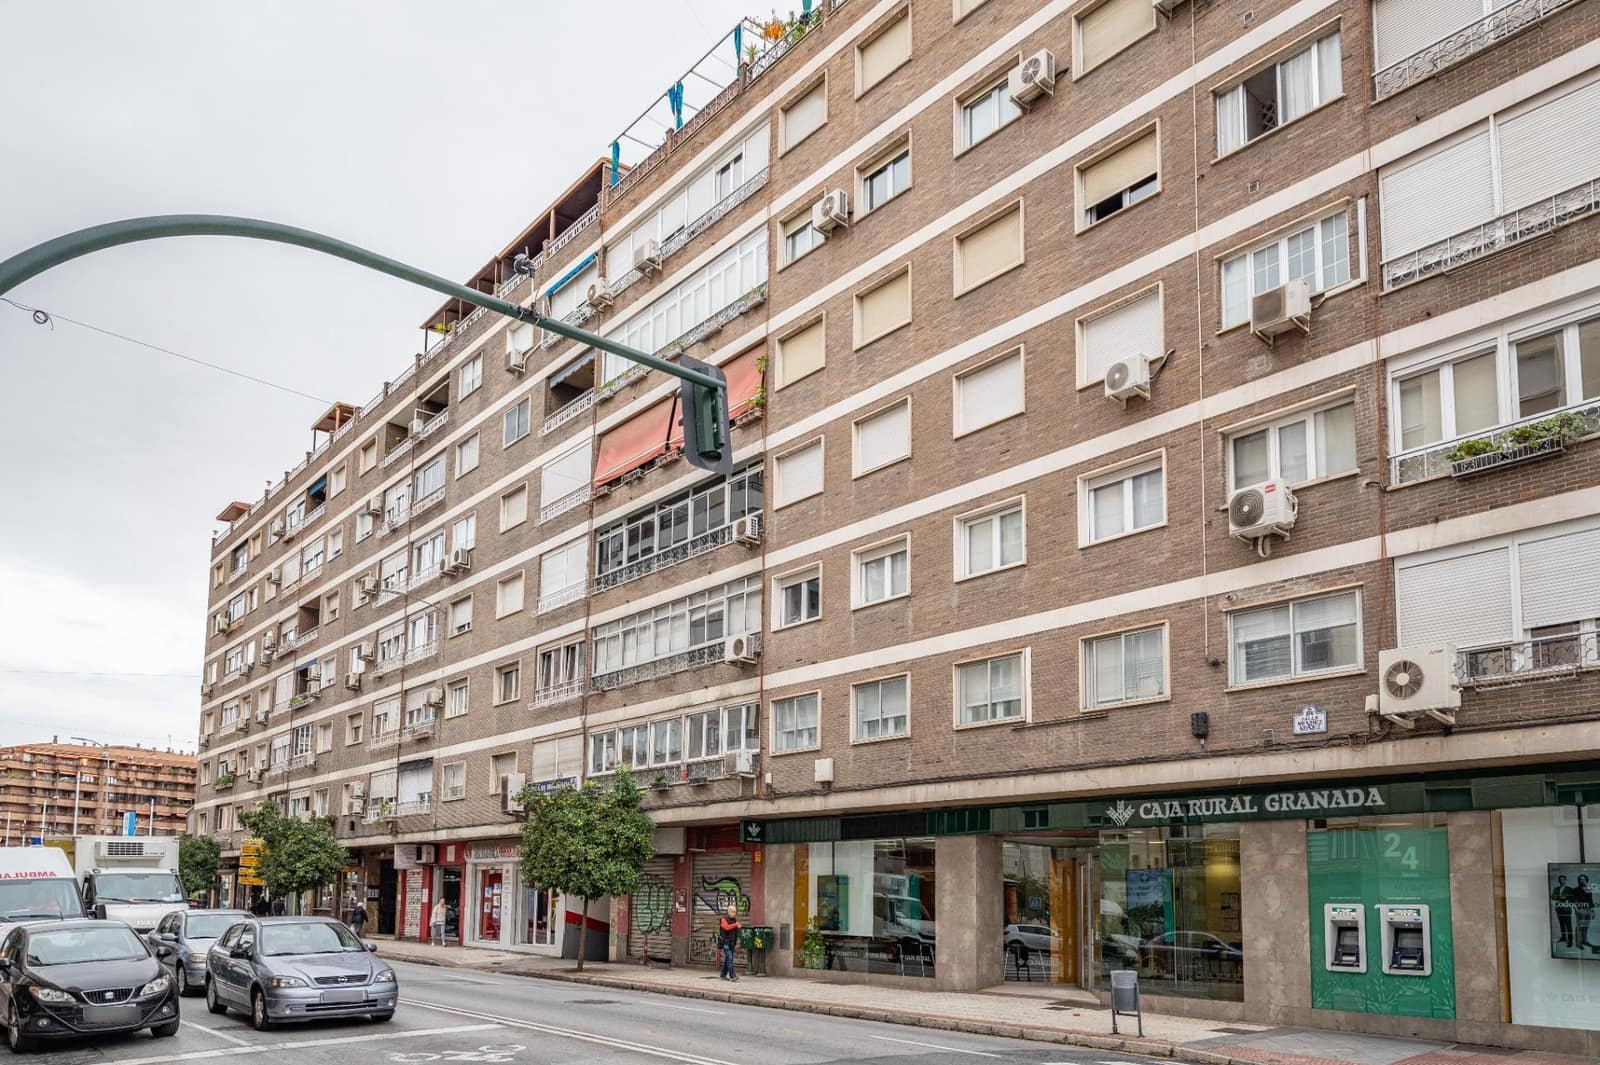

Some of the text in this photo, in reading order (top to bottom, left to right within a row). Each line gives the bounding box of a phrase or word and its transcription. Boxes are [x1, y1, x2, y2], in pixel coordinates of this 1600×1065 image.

[1139, 788, 1385, 819] CAJA RURAL GRANADA
